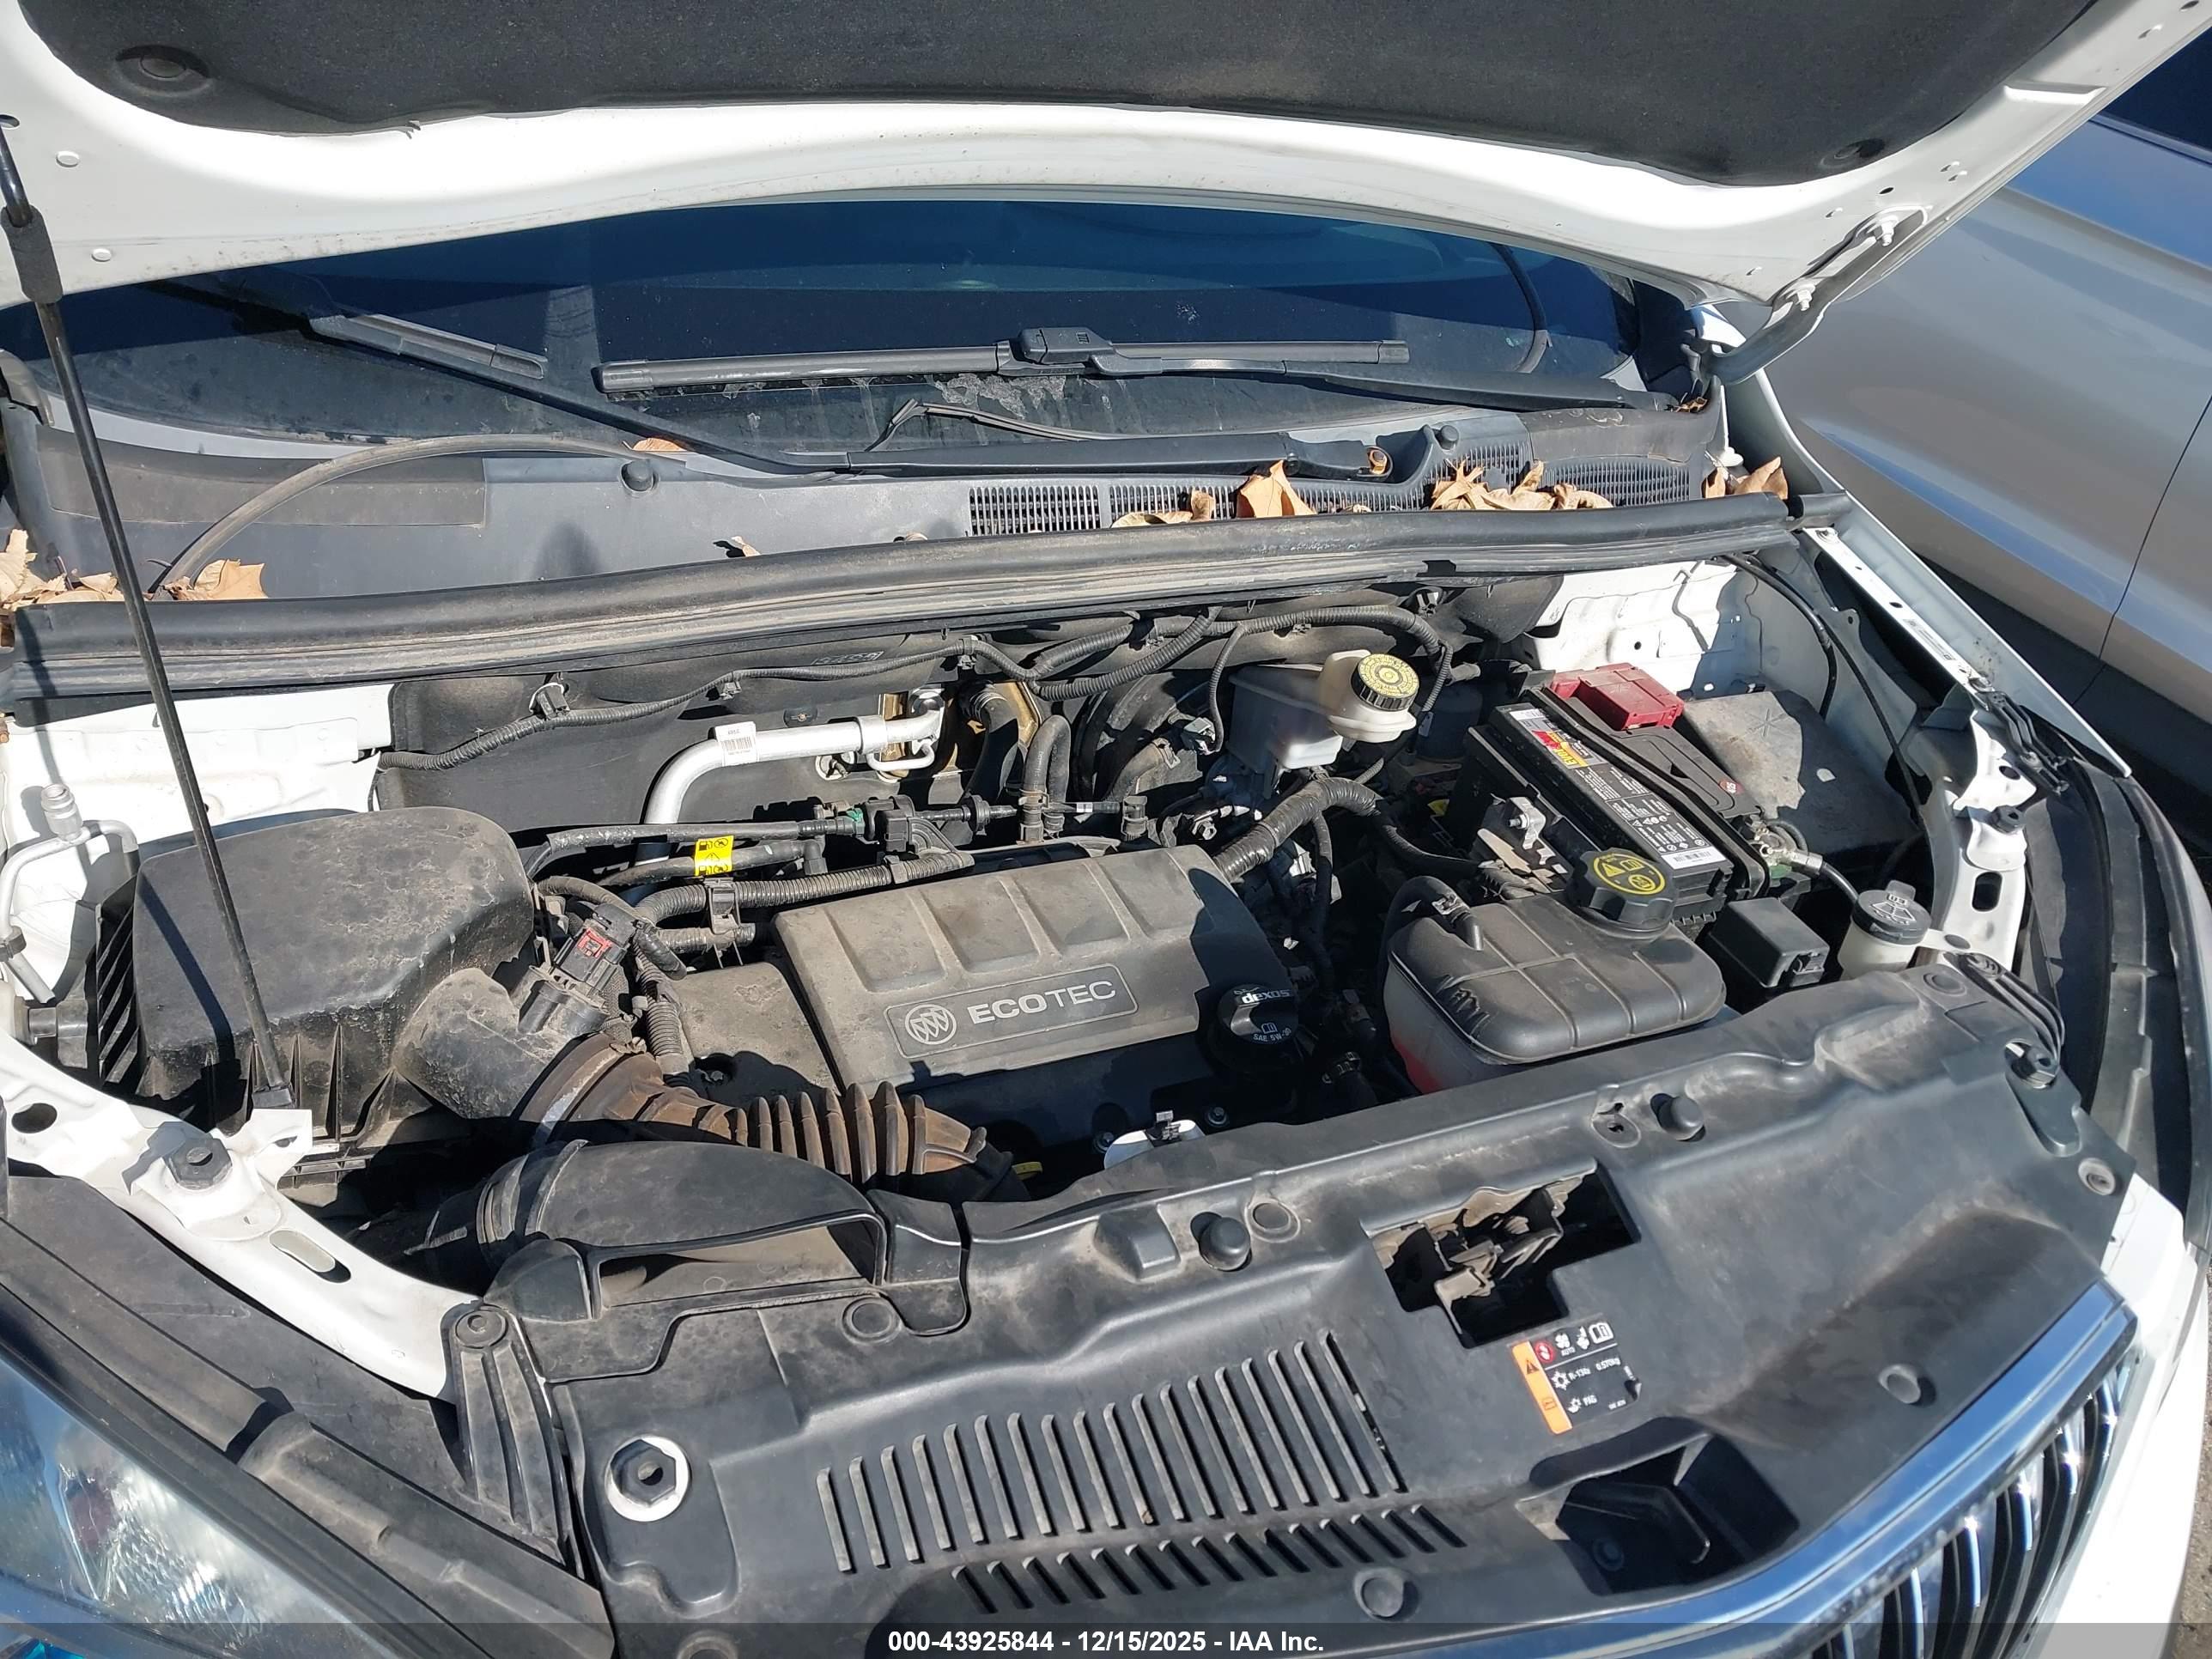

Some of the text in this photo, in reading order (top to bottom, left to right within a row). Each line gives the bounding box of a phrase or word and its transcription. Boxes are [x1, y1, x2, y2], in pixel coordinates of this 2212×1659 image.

[967, 981, 1116, 1024] ECOTEC
[1242, 989, 1290, 1004] dexos
[1253, 1033, 1268, 1042] SAE
